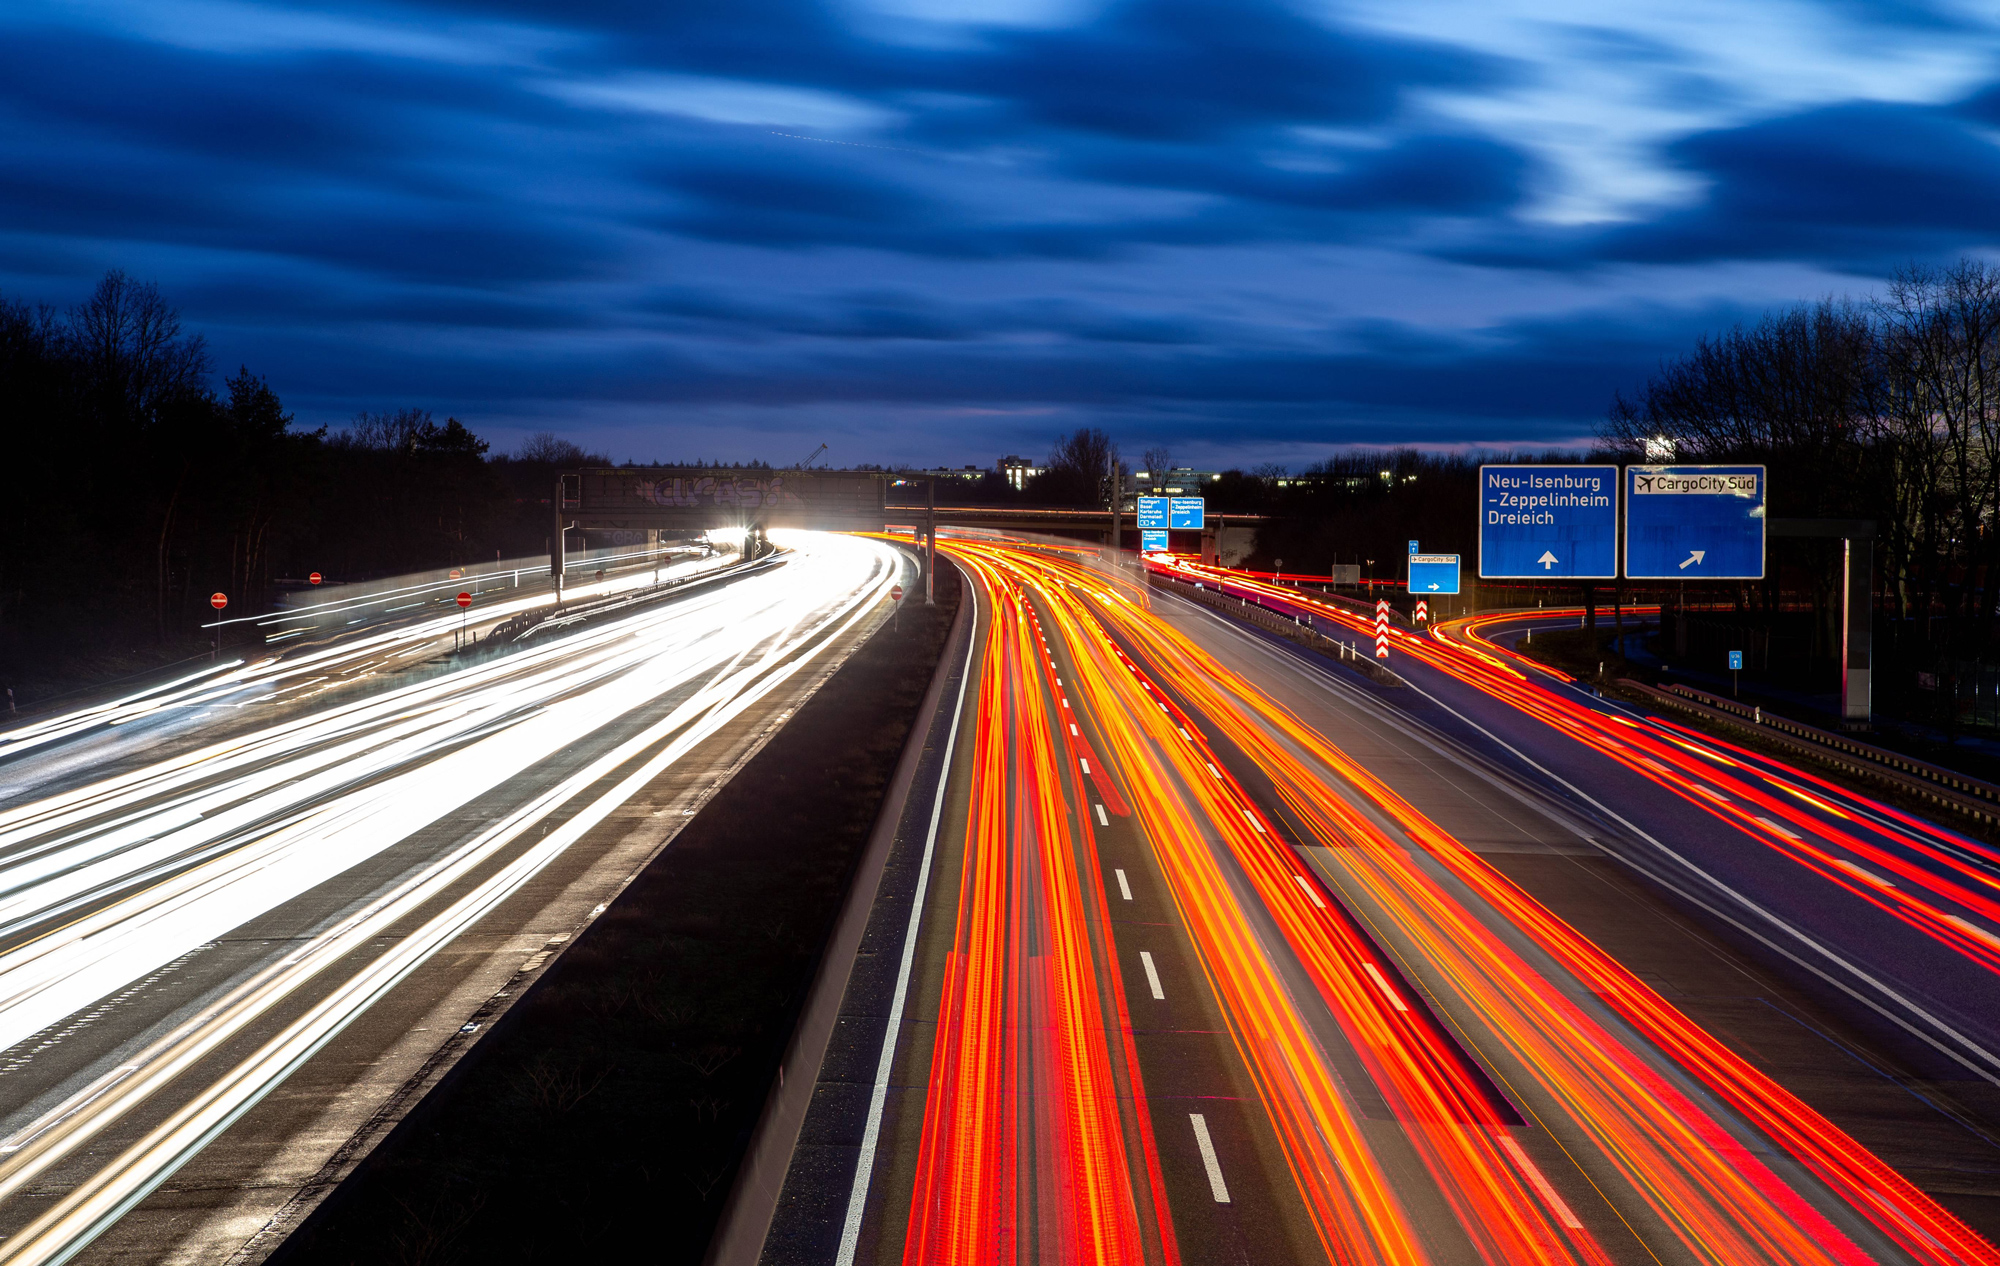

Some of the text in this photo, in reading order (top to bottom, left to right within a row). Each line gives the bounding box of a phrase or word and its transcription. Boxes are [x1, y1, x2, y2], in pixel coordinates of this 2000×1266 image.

[1489, 474, 1601, 492] Neu-Isenburg
[1657, 476, 1755, 493] CargoCity Süd
[1488, 510, 1554, 525] Dreieich
